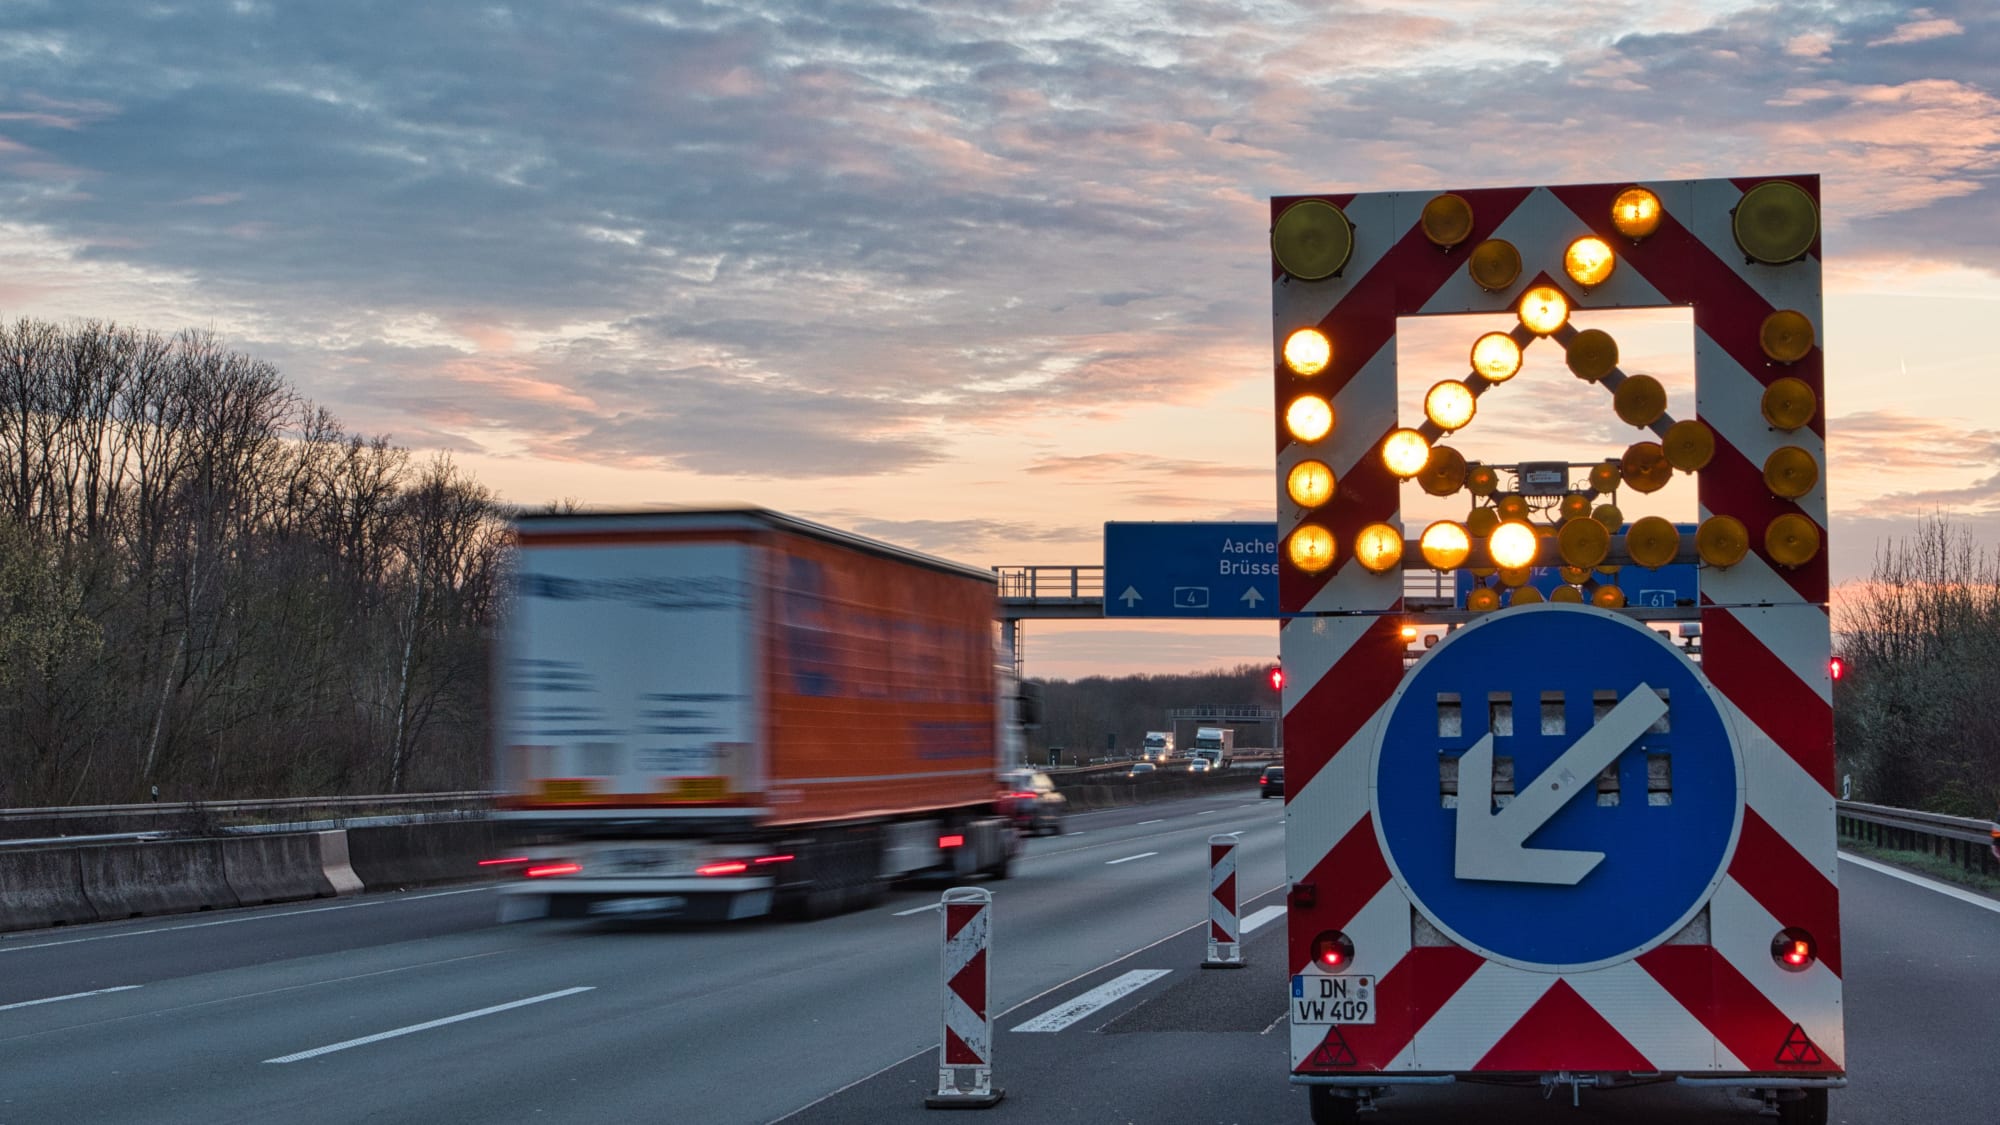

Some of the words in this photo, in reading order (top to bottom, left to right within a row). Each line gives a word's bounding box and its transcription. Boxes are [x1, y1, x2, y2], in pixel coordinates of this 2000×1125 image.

[1186, 591, 1196, 604] 4
[1651, 593, 1665, 607] 61
[1320, 979, 1346, 999] DN
[1299, 1001, 1325, 1020] VW
[1330, 1001, 1368, 1020] 409
